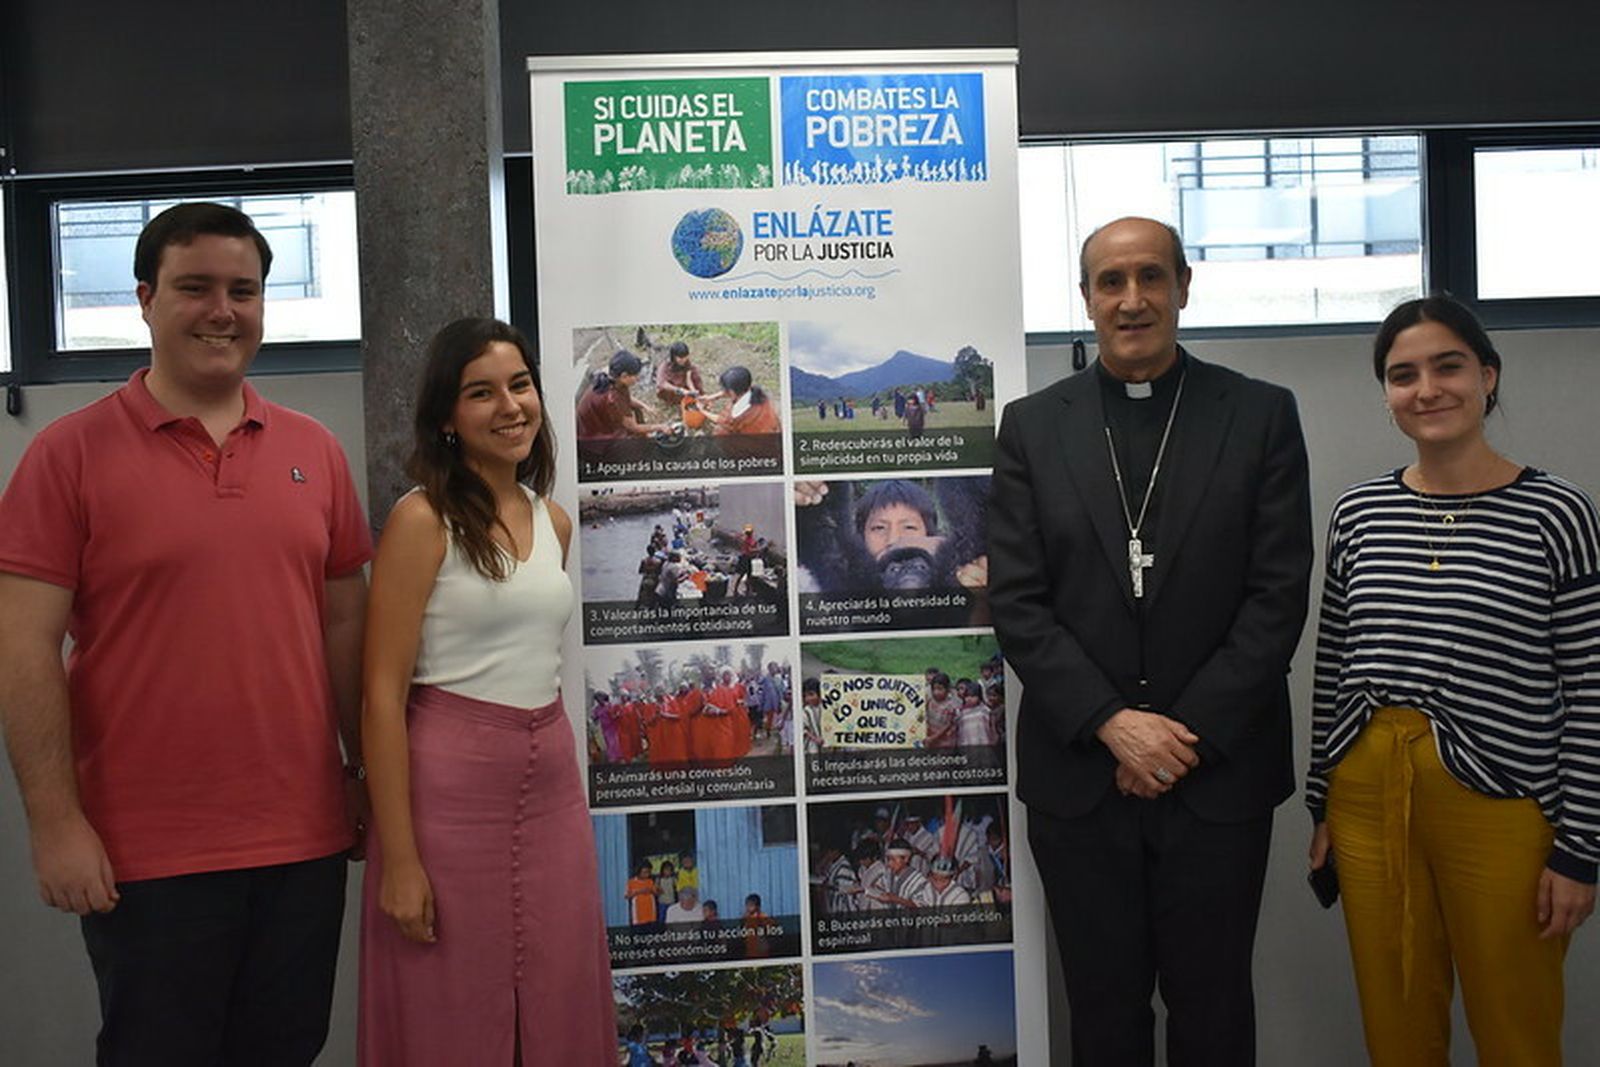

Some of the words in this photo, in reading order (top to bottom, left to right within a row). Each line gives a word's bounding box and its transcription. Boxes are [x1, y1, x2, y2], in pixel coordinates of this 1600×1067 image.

[594, 96, 615, 120] SI
[620, 94, 708, 119] CUIDAS
[714, 93, 743, 117] EL
[806, 88, 926, 111] COMBATES
[931, 87, 959, 109] LA
[594, 120, 747, 156] PLANETA
[806, 113, 963, 148] POBREZA
[753, 204, 894, 239] ENLÁZATE
[753, 243, 789, 261] POR
[792, 244, 815, 261] LA
[817, 241, 894, 261] JUSTICIA
[688, 284, 876, 301] www.enlazateporlajusticia.org
[800, 440, 811, 451] 2.
[813, 438, 892, 451] Redescubrirás
[895, 438, 905, 449] el
[907, 437, 935, 448] valor
[937, 436, 951, 447] de
[954, 435, 964, 446] la
[585, 464, 595, 474] 1.
[597, 460, 650, 475] Apoyarás
[653, 460, 663, 471] la
[665, 460, 699, 471] causa
[702, 458, 716, 469] de
[718, 458, 735, 468] los
[738, 457, 777, 471] pobres
[800, 453, 864, 468] simplicidad
[866, 454, 881, 463] en
[883, 453, 895, 462] tu
[897, 452, 932, 465] propia
[935, 451, 958, 461] vida
[591, 610, 600, 621] 3.
[602, 607, 656, 620] Valorarás
[658, 608, 669, 618] la
[671, 604, 740, 619] importancia
[742, 603, 755, 614] de
[758, 603, 776, 613] tus
[805, 600, 816, 611] 4.
[818, 597, 877, 612] Apreciarás
[879, 598, 890, 608] la
[892, 595, 950, 607] diversidad
[952, 595, 966, 605] de
[590, 621, 691, 638] comportamientos
[693, 619, 752, 631] cotidianos
[806, 613, 849, 626] nuestro
[851, 613, 891, 624] mundo
[822, 689, 840, 709] NO
[843, 677, 874, 692] NOS
[877, 678, 924, 708] QUITEN
[833, 704, 852, 722] LO
[861, 699, 905, 715] UNICO
[857, 716, 887, 728] QUE
[835, 732, 906, 744] TENEMOS
[812, 760, 823, 771] 6.
[824, 757, 887, 773] Impulsarás
[889, 757, 905, 767] las
[907, 754, 968, 767] decisiones
[608, 770, 662, 783] Animarás
[664, 771, 686, 780] una
[688, 766, 751, 779] conversión
[813, 773, 877, 786] necesarias,
[879, 772, 920, 783] aunque
[923, 769, 950, 780] sean
[952, 768, 1003, 779] costosas
[596, 786, 649, 801] personal,
[651, 783, 695, 796] eclesial
[697, 784, 705, 796] y
[707, 780, 775, 793] comunitaria
[818, 921, 829, 931] 8.
[831, 916, 883, 931] Bucearás
[885, 918, 900, 926] en
[902, 917, 914, 926] tu
[916, 914, 950, 928] propia
[952, 912, 1001, 923] tradición
[616, 935, 631, 945] No
[633, 928, 701, 946] supeditarás
[703, 929, 715, 939] tu
[717, 927, 755, 938] acción
[767, 925, 783, 935] los
[818, 933, 872, 948] espiritual
[659, 943, 728, 956] económicos
